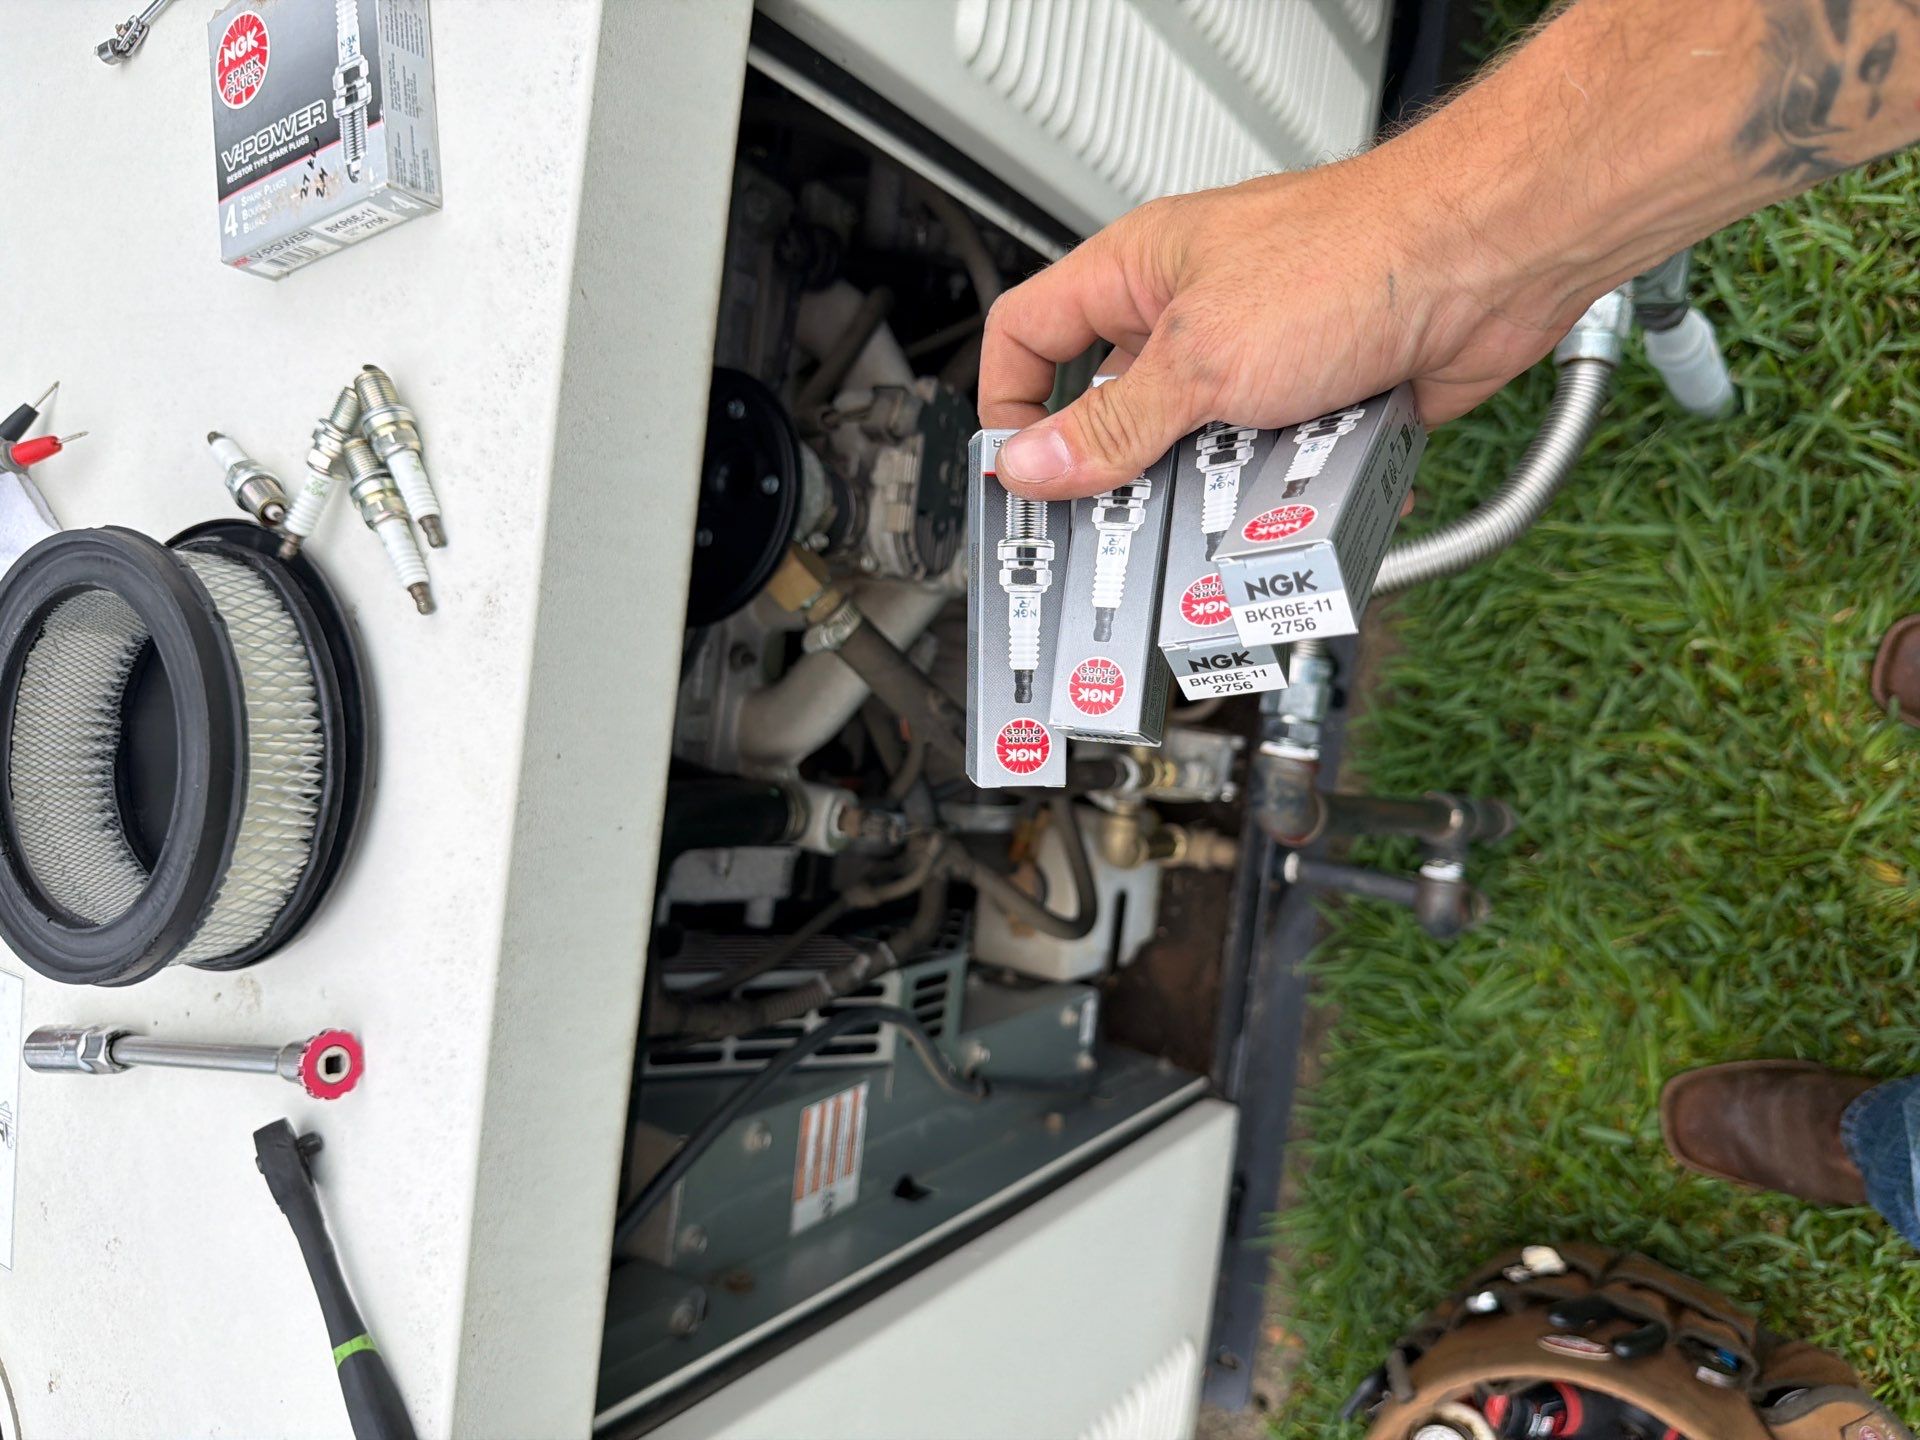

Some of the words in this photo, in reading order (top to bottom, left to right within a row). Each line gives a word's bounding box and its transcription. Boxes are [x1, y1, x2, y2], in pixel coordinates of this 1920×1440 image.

[224, 27, 259, 67] NGK
[227, 56, 259, 84] SPARK
[228, 70, 260, 97] PLUGS
[221, 99, 327, 172] V-POWER
[226, 164, 253, 184] RESISTOR
[253, 156, 268, 169] TYPE
[268, 146, 288, 161] SPARK
[288, 135, 310, 151] PLUGS
[224, 204, 238, 237] 4
[1209, 480, 1236, 491] NGK
[1252, 520, 1302, 537] NGK
[1101, 546, 1126, 556] NGK
[1194, 583, 1218, 591] UGS
[1243, 569, 1318, 601] NGK
[1195, 591, 1224, 599] PARK
[1013, 609, 1037, 618] NGK
[1245, 598, 1333, 624] BKR6E-11
[1271, 617, 1317, 636] 2756
[1188, 650, 1255, 673] NGK
[1081, 666, 1116, 676] PLUGS
[1081, 675, 1116, 684] SPARK
[1189, 669, 1268, 687] BKR6E-11
[1077, 687, 1116, 703] NGK
[1213, 681, 1253, 694] 2756
[1005, 748, 1042, 762] NGK
